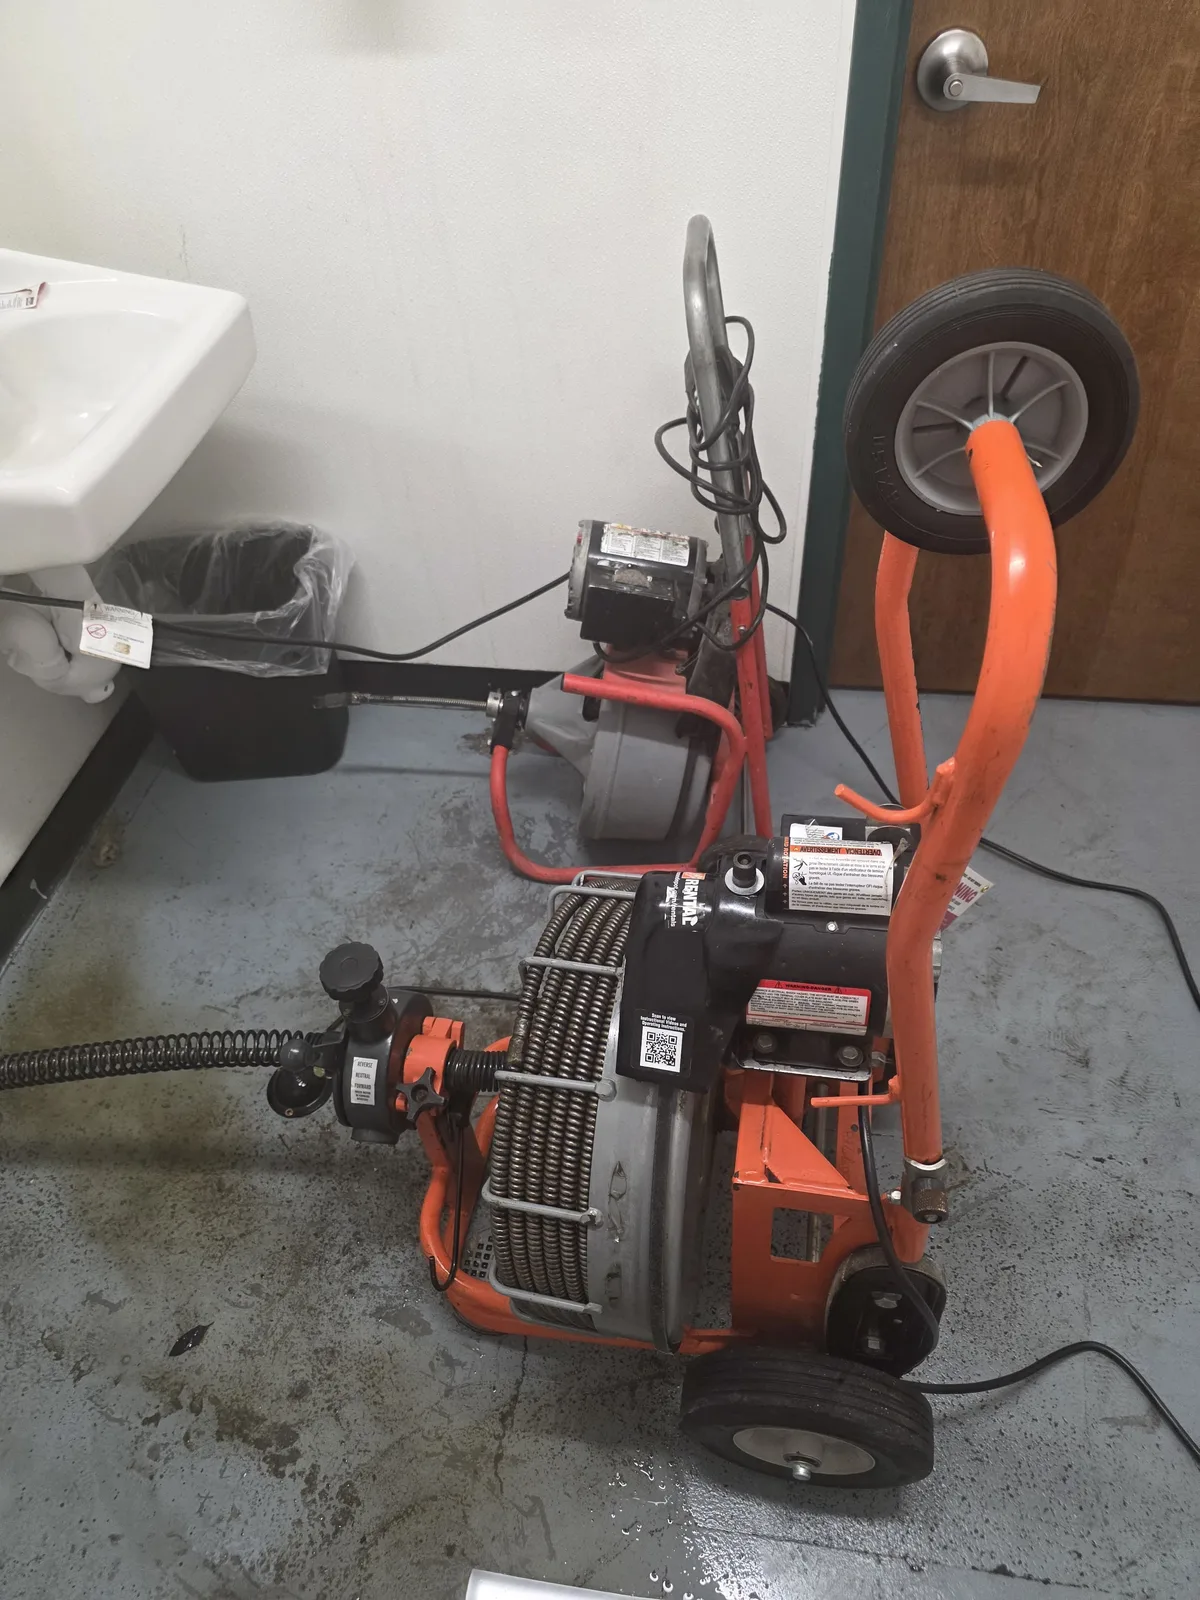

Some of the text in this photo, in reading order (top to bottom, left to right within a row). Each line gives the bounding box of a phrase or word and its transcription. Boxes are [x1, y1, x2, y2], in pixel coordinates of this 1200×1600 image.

[800, 845, 841, 855] AVERTISSEMENT
[682, 878, 699, 926] RENTAL
[955, 882, 978, 904] NING
